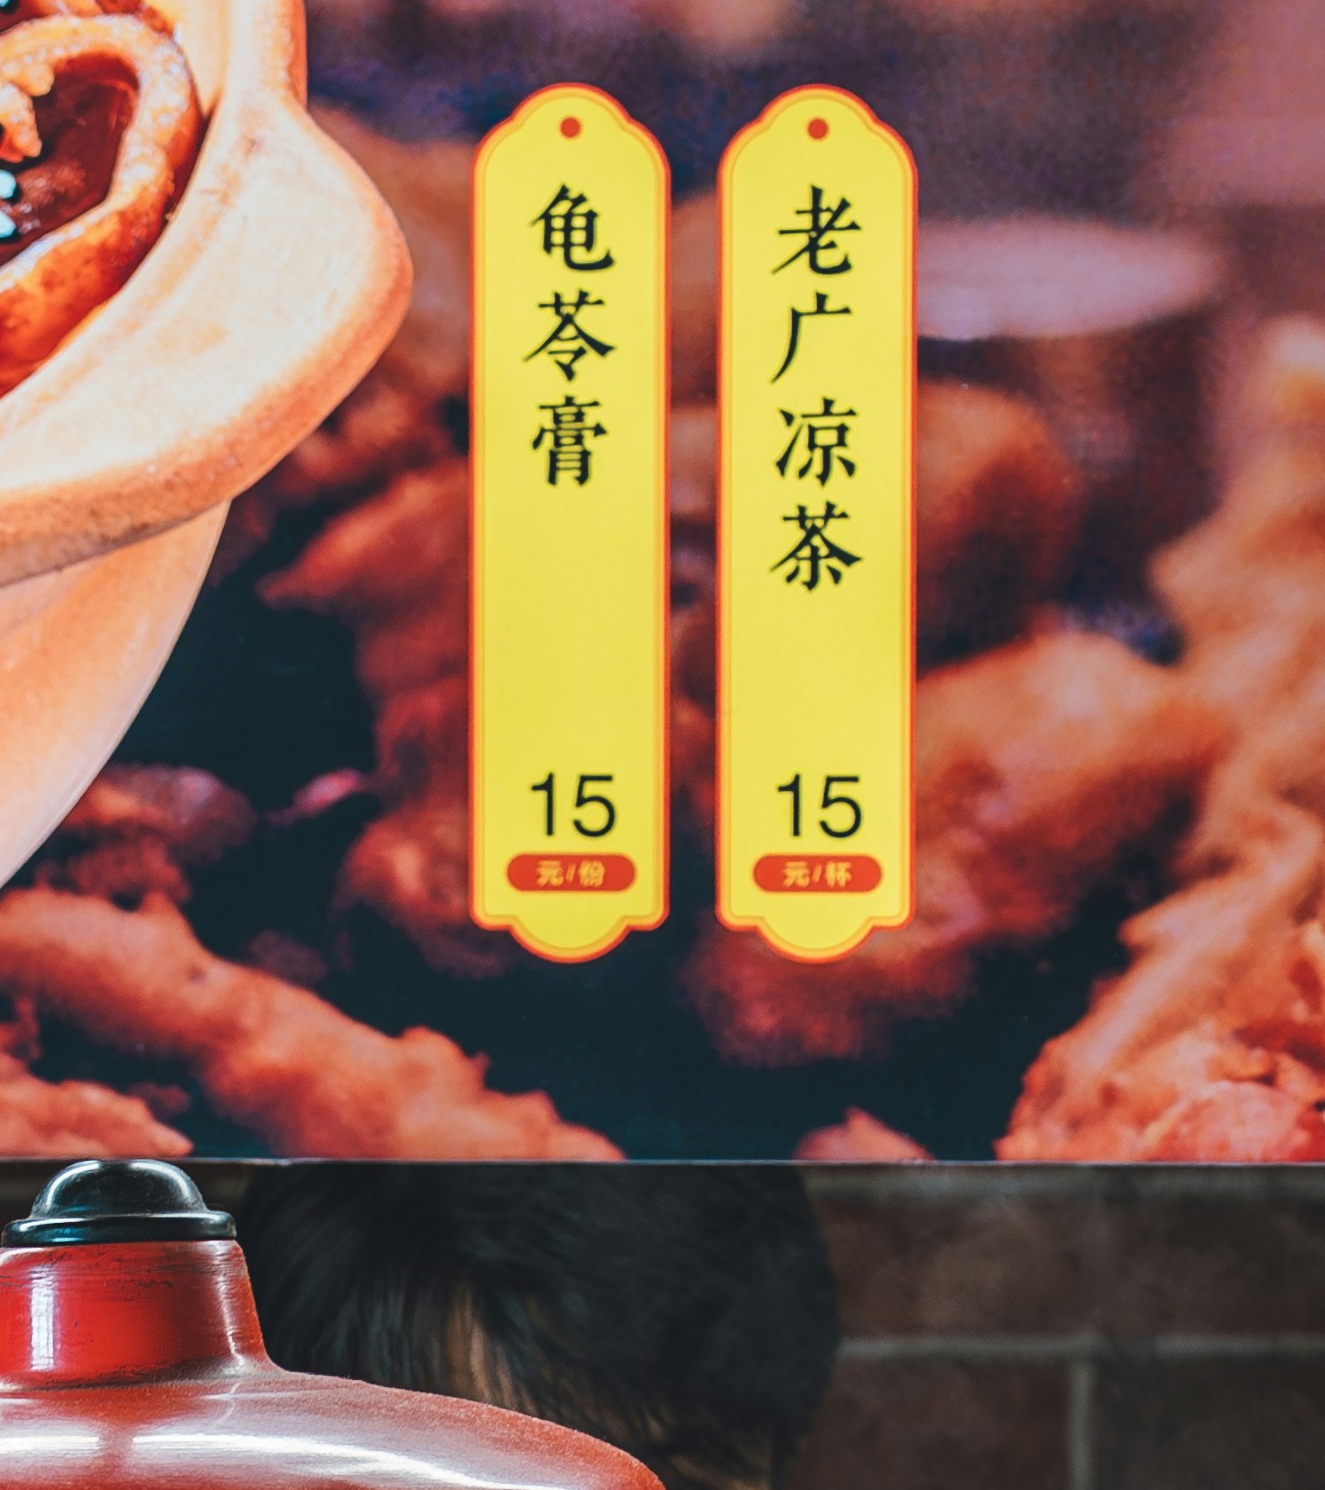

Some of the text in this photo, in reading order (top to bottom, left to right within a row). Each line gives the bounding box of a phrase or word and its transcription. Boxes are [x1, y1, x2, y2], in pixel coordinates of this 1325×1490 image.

[528, 184, 615, 486] 龟苓膏
[772, 185, 862, 591] 老广凉茶
[531, 772, 616, 838] 15
[777, 773, 862, 839] 15
